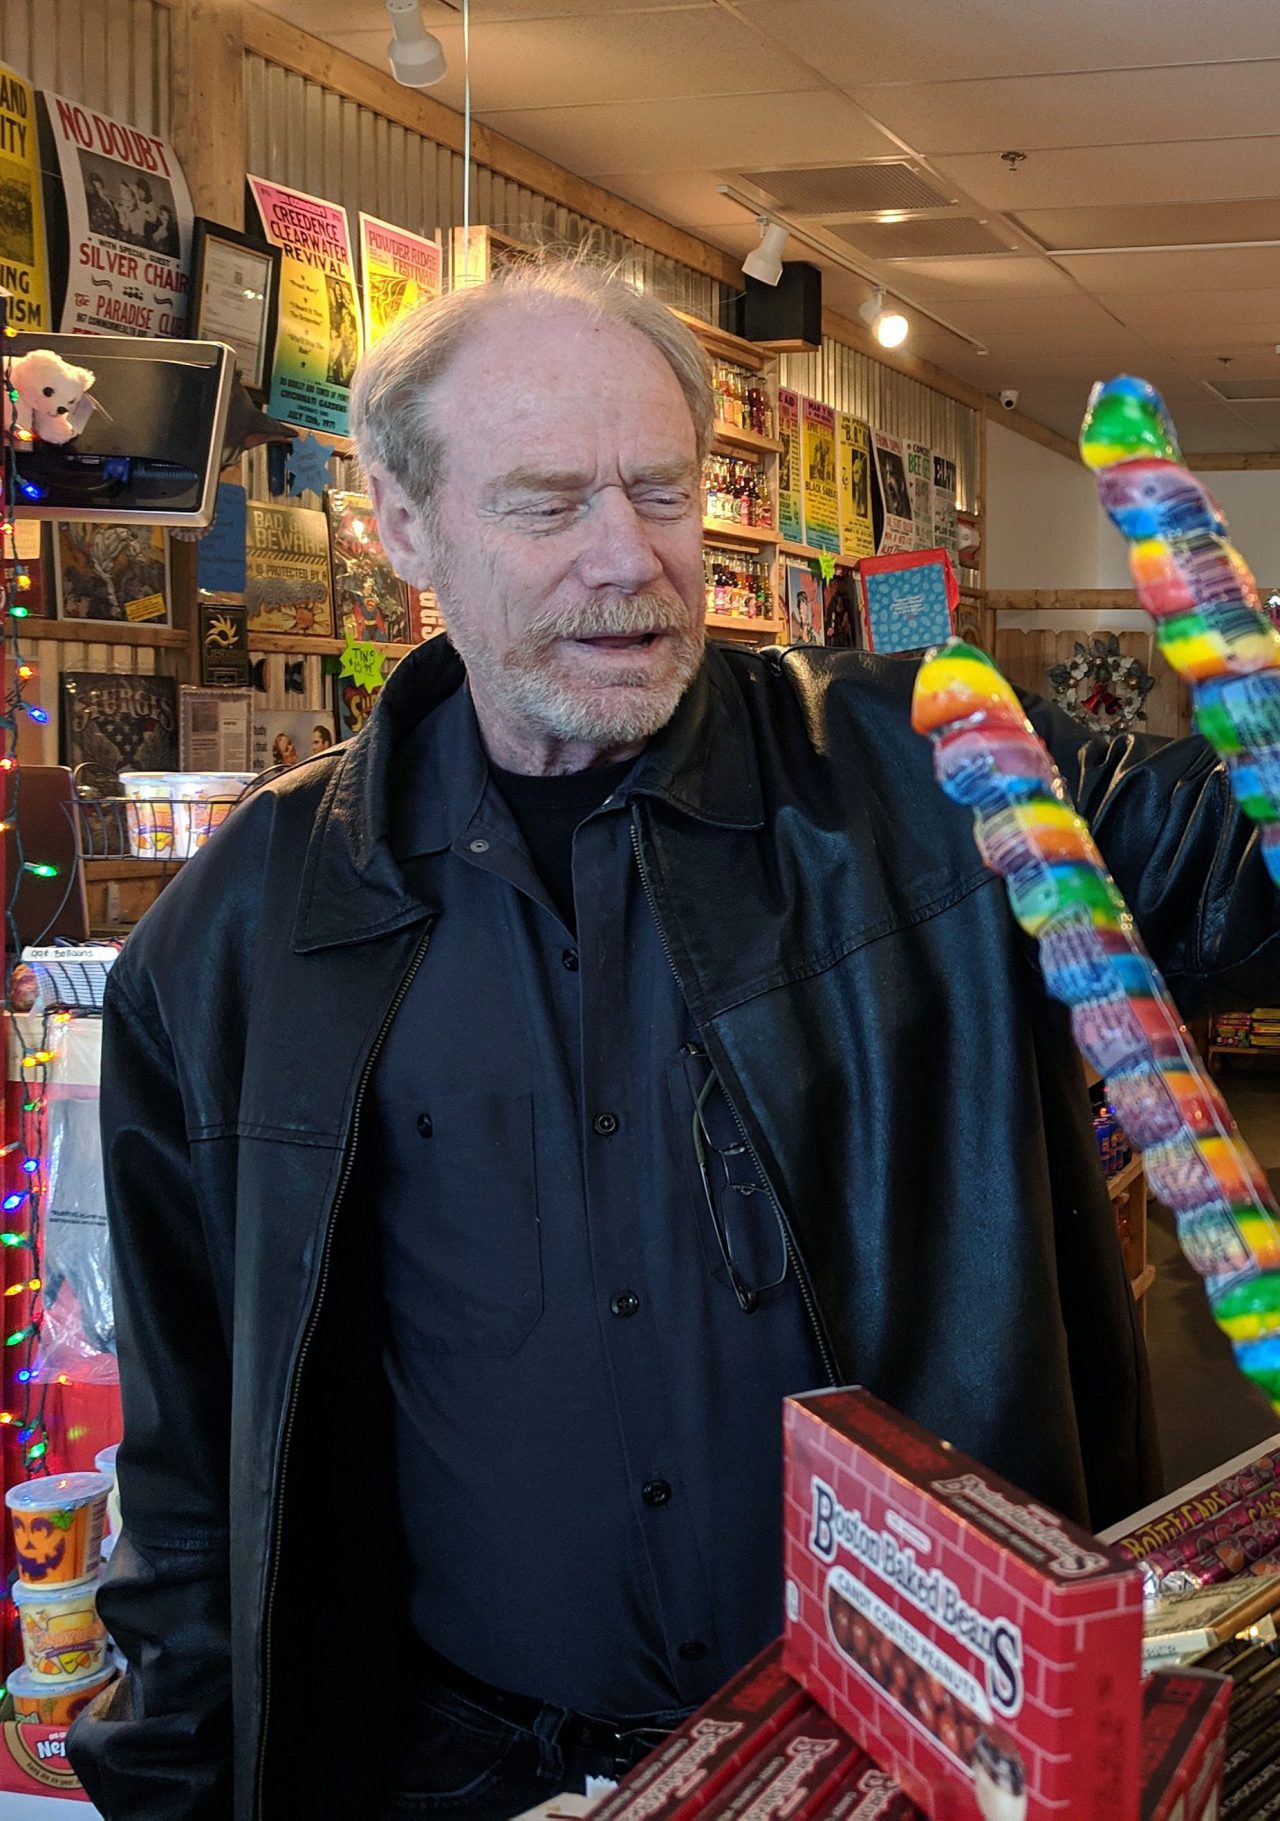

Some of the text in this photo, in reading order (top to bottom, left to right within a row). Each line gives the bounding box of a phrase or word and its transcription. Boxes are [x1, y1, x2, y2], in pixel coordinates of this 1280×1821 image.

[0, 114, 26, 159] ITY
[55, 98, 171, 178] NO DOUBT
[272, 203, 340, 243] CREEDENCE
[119, 243, 147, 260] SPECIAL
[150, 254, 171, 268] GUEST
[270, 220, 349, 265] CLEARWATER
[368, 230, 409, 261] POWDER
[0, 264, 30, 294] ING
[79, 242, 191, 294] SILVER CHAIR
[283, 243, 346, 279] REVIVAL
[9, 296, 42, 327] ISM
[96, 295, 155, 331] PARADISE
[253, 510, 284, 531] BAD
[255, 528, 326, 555] BEWARE
[265, 564, 309, 580] PROTECTED
[310, 569, 321, 580] BY
[813, 1483, 881, 1570] Boston
[881, 1535, 941, 1616] Baked
[838, 1572, 977, 1704] CANDY COATED PEANUTS
